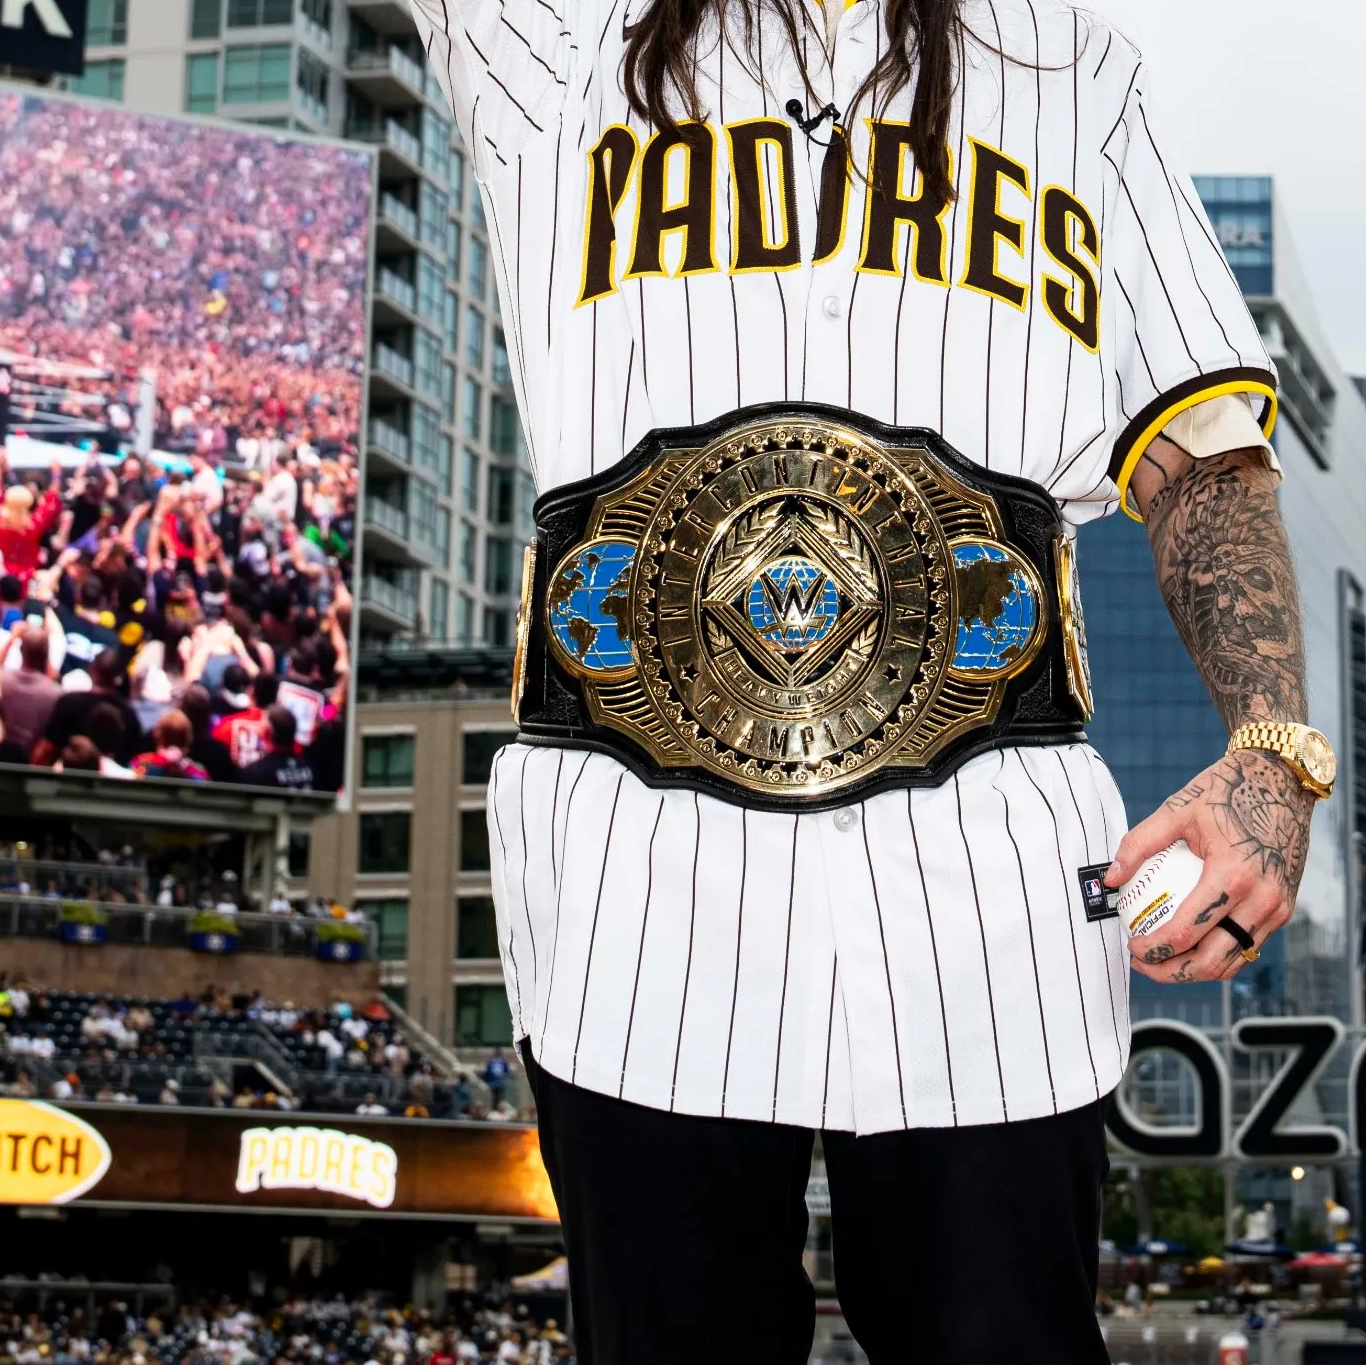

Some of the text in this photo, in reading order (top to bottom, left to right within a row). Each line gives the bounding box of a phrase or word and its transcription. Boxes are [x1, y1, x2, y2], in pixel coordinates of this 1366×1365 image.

[573, 115, 1100, 355] PADRES
[658, 455, 928, 648] INTERCONTINENTAL
[693, 689, 888, 757] CHAMPION
[1138, 905, 1170, 936] OFFICIAL
[240, 1130, 395, 1204] PADRES
